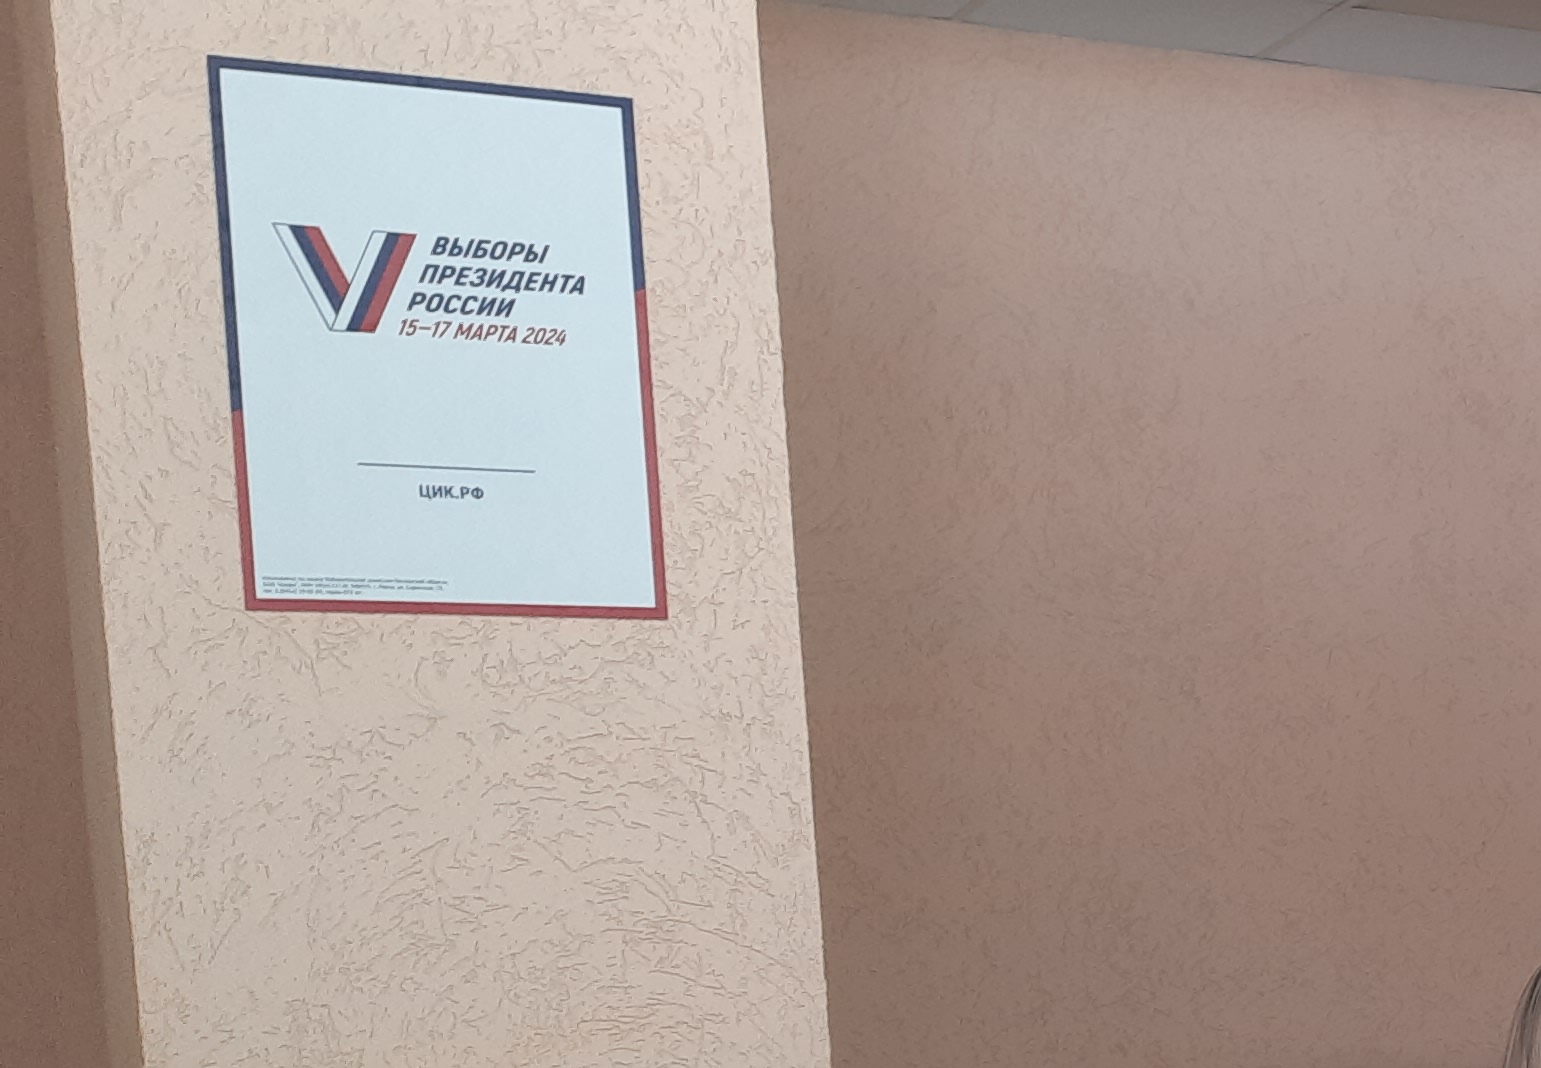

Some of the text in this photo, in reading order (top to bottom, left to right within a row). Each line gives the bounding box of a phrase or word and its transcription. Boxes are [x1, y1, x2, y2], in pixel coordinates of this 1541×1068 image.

[430, 236, 550, 263] ВЫБОРЫ
[418, 264, 586, 295] ПРЕЗИДЕНТА
[407, 292, 516, 318] РОССИИ
[453, 322, 518, 343] МАРТА
[521, 326, 567, 346] 2024
[419, 484, 484, 501] ЦИК.РФ
